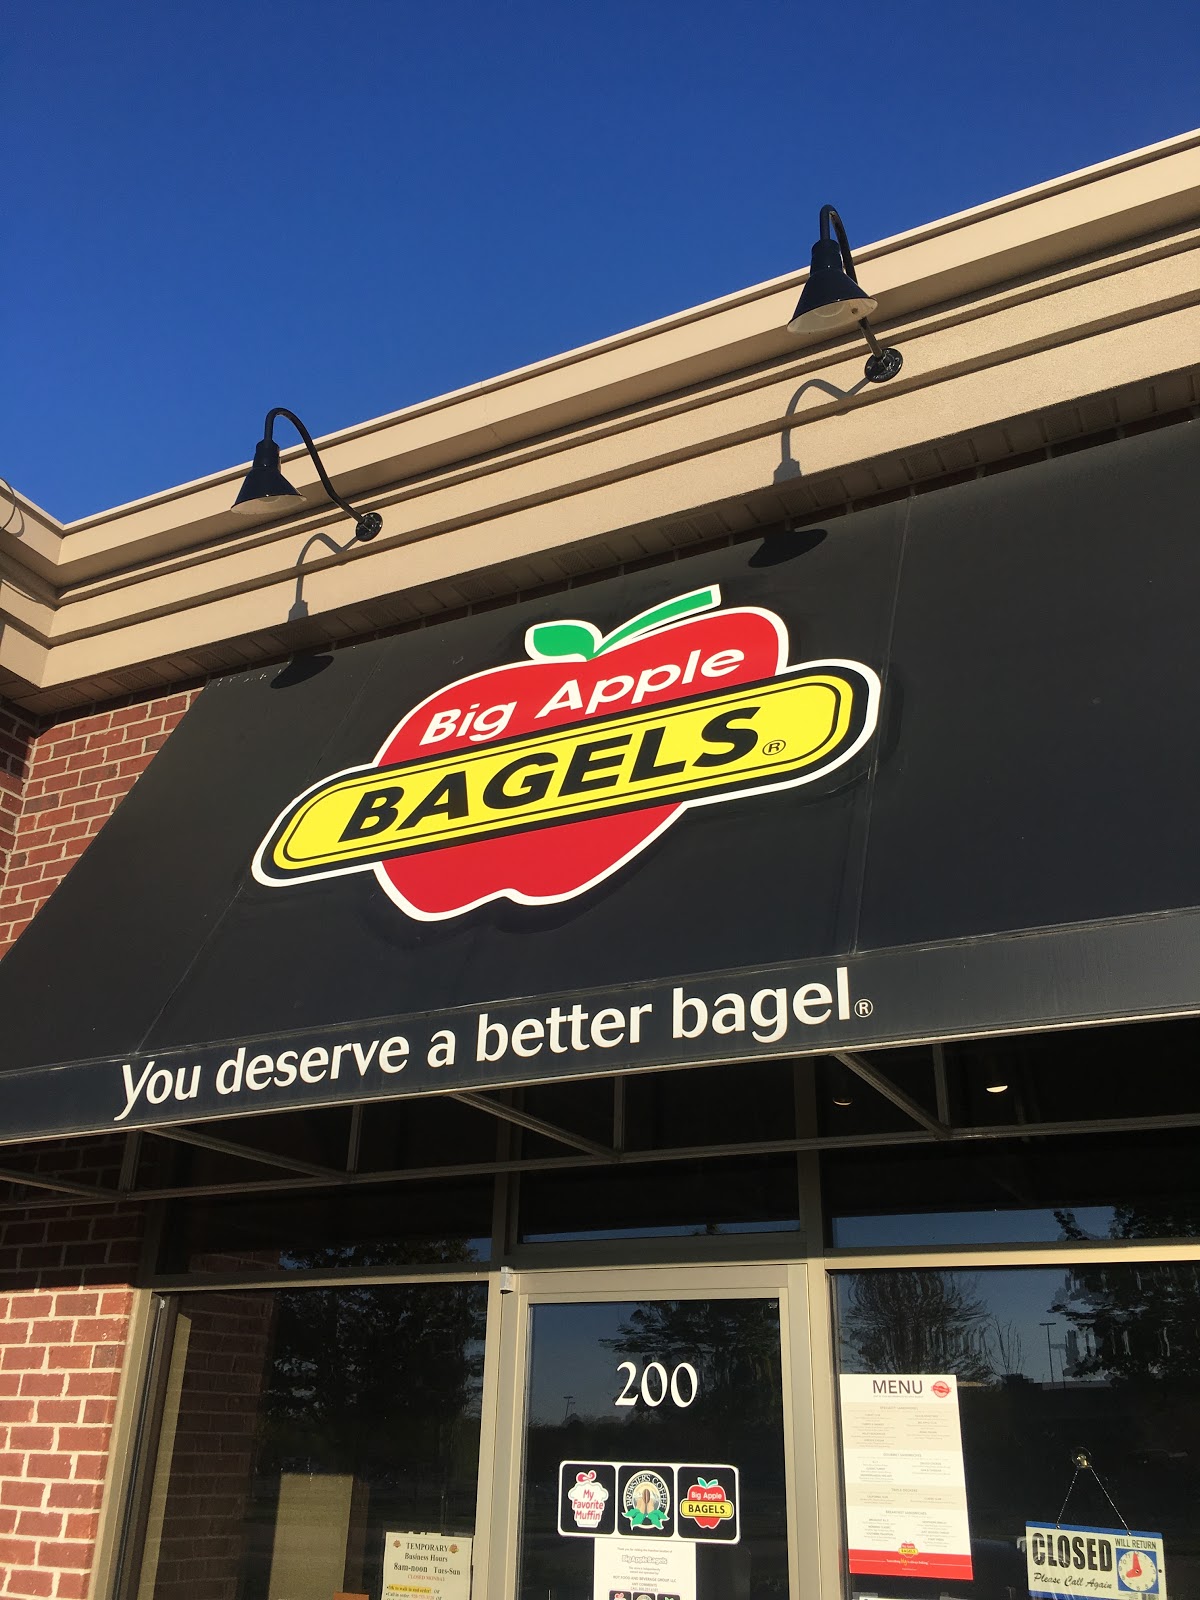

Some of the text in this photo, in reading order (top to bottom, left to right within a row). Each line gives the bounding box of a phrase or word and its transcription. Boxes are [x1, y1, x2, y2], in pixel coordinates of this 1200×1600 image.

[418, 649, 745, 746] Big Apple
[337, 706, 761, 843] BAGELS
[215, 1036, 410, 1095] deserve
[427, 1029, 456, 1068] a
[476, 1003, 653, 1062] better
[672, 966, 851, 1044] bagel
[614, 1361, 698, 1408] 200
[872, 1379, 923, 1395] MENU
[583, 1489, 595, 1501] My
[652, 1477, 668, 1509] COFFEE
[691, 1491, 723, 1501] Big Apple
[572, 1500, 604, 1510] Favorite
[688, 1504, 726, 1514] BAGELS
[575, 1511, 601, 1521] Muffin
[406, 1542, 449, 1552] TEMPORARY
[1115, 1538, 1157, 1550] WILL RETURN
[404, 1553, 448, 1563] Business Hours
[1032, 1532, 1113, 1572] CLOSED
[393, 1562, 461, 1576] 8am-noon Tues-Sun
[1033, 1572, 1113, 1591] Please Call Again
